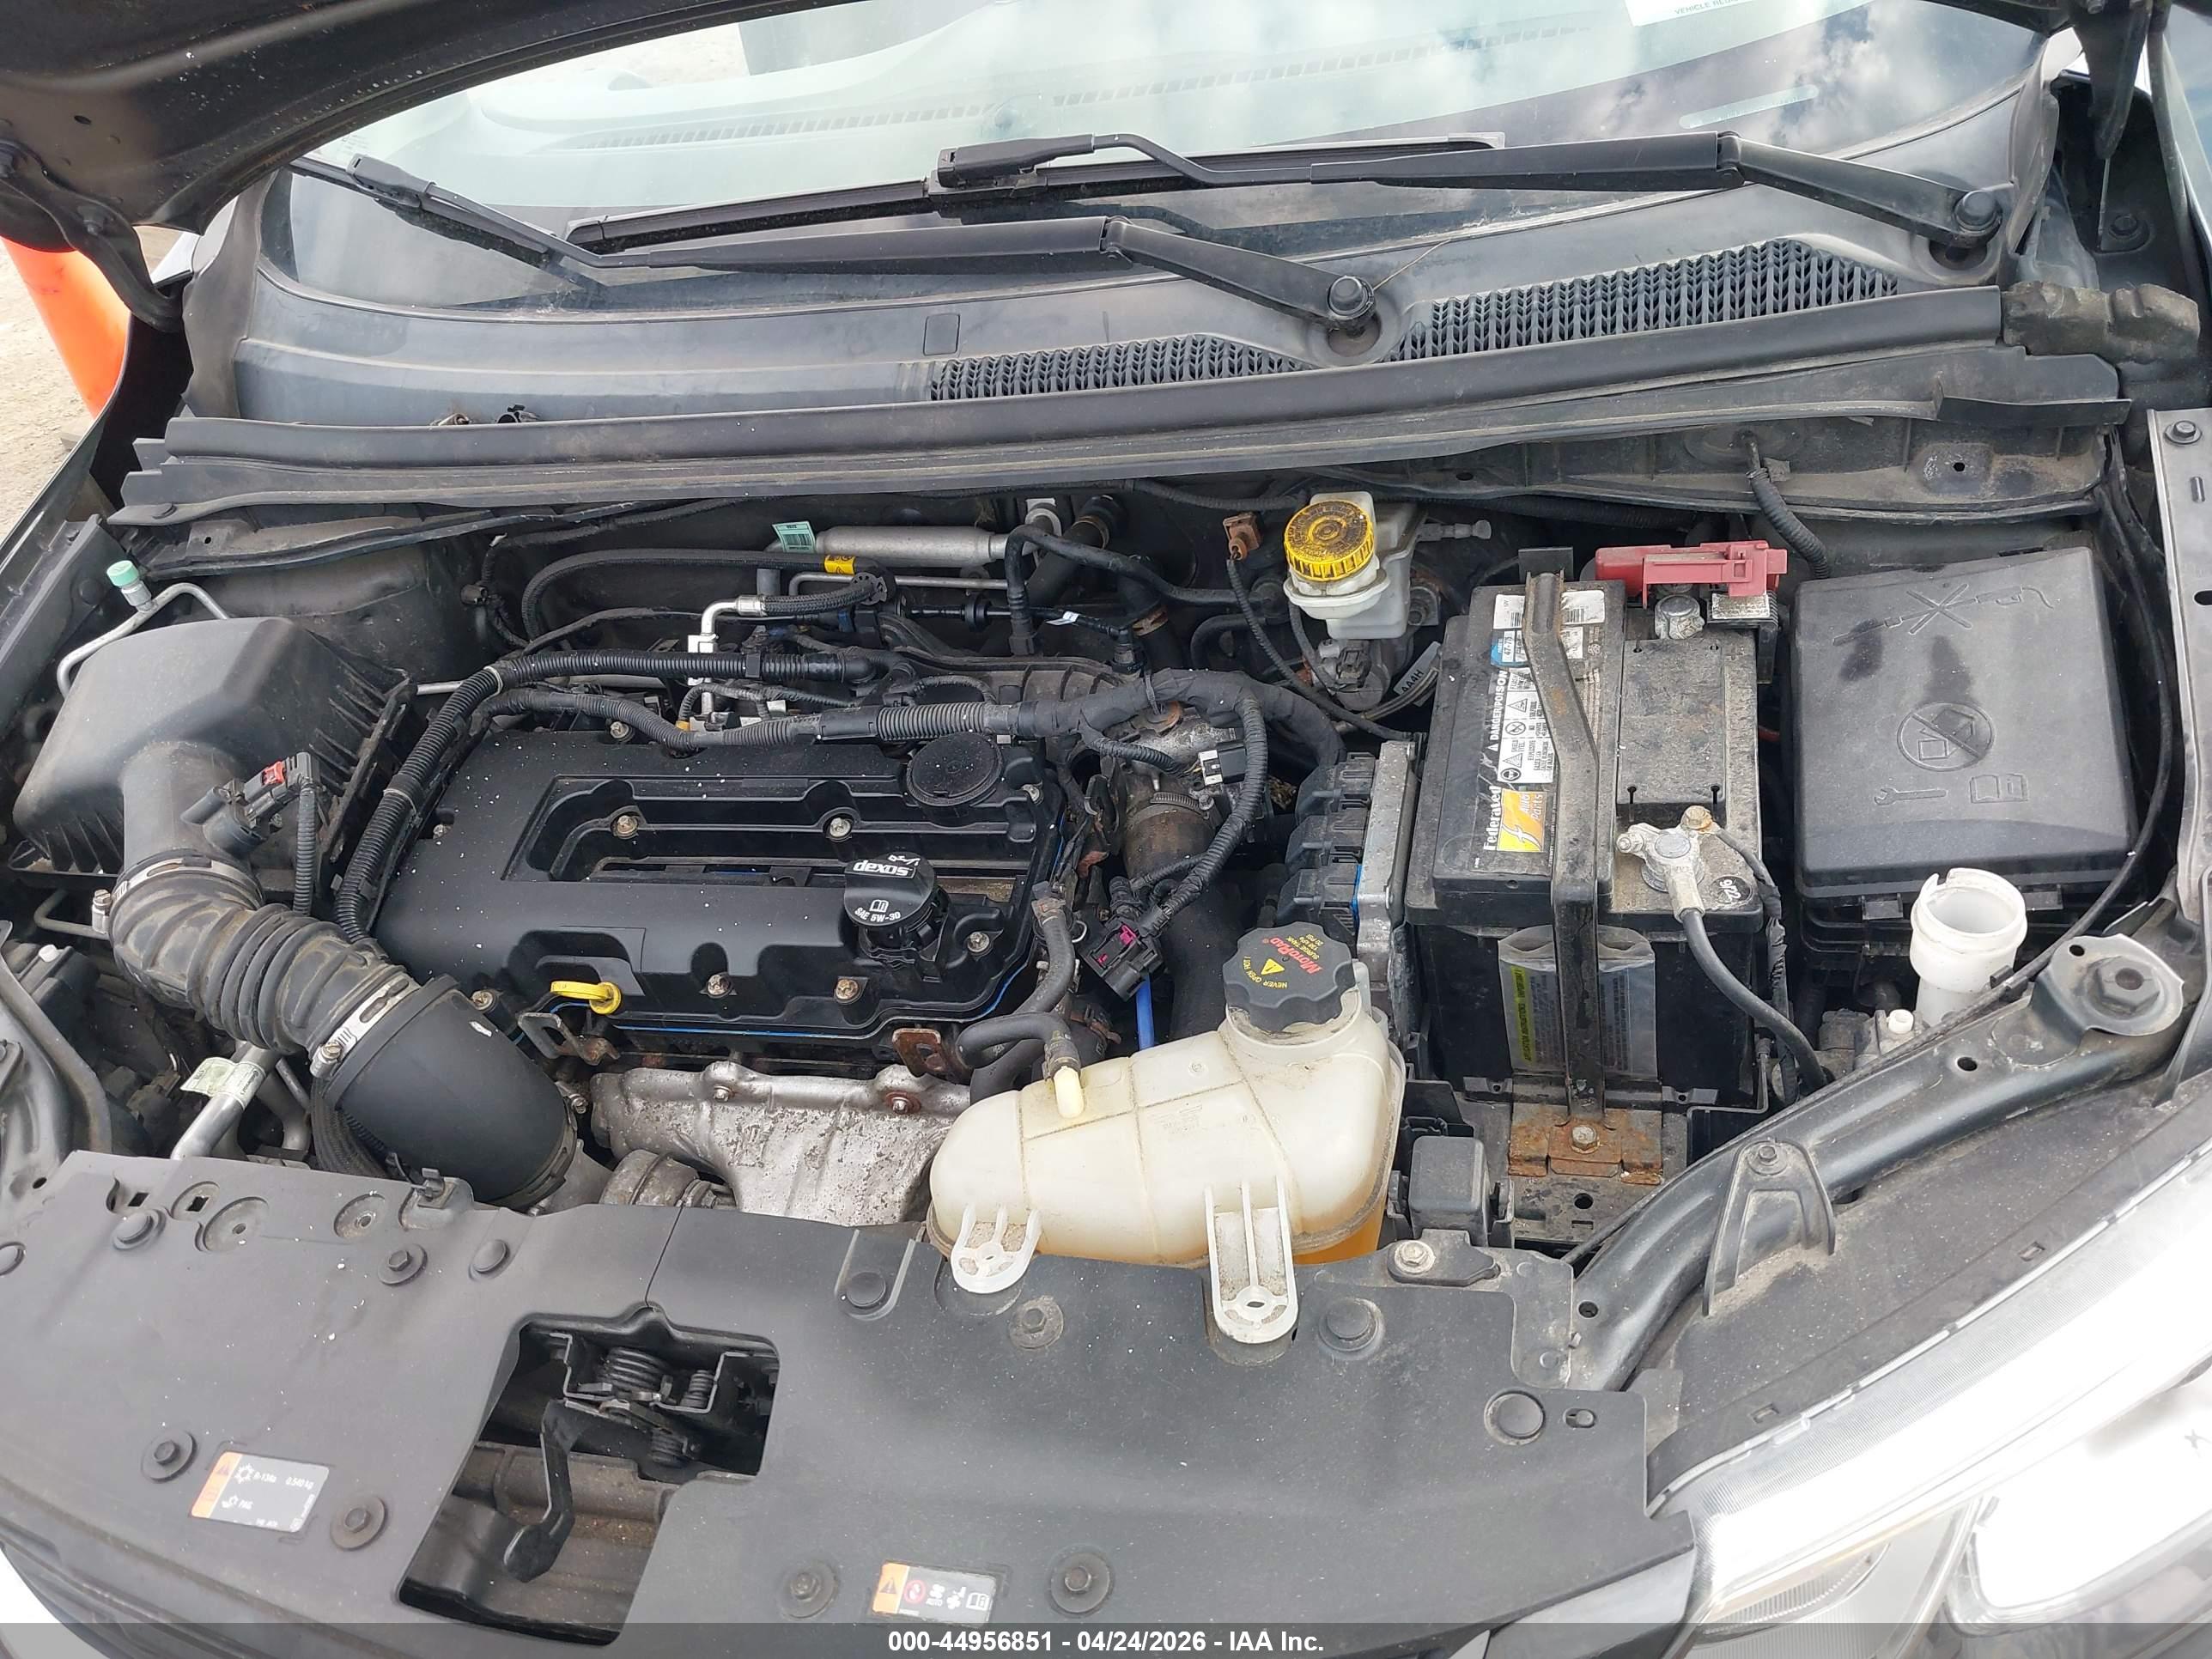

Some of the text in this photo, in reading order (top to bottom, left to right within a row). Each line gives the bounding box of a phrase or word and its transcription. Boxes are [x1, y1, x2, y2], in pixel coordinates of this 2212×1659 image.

[1674, 3, 1711, 15] VEHICLE
[1490, 670, 1509, 740] DANGER/POISON
[1483, 785, 1502, 850] Federated
[853, 860, 909, 876] dexos
[854, 907, 902, 922] SAE 5W-30
[1298, 945, 1320, 960] SURGE
[1246, 969, 1262, 983] OPEN
[1262, 980, 1288, 989] NEVER
